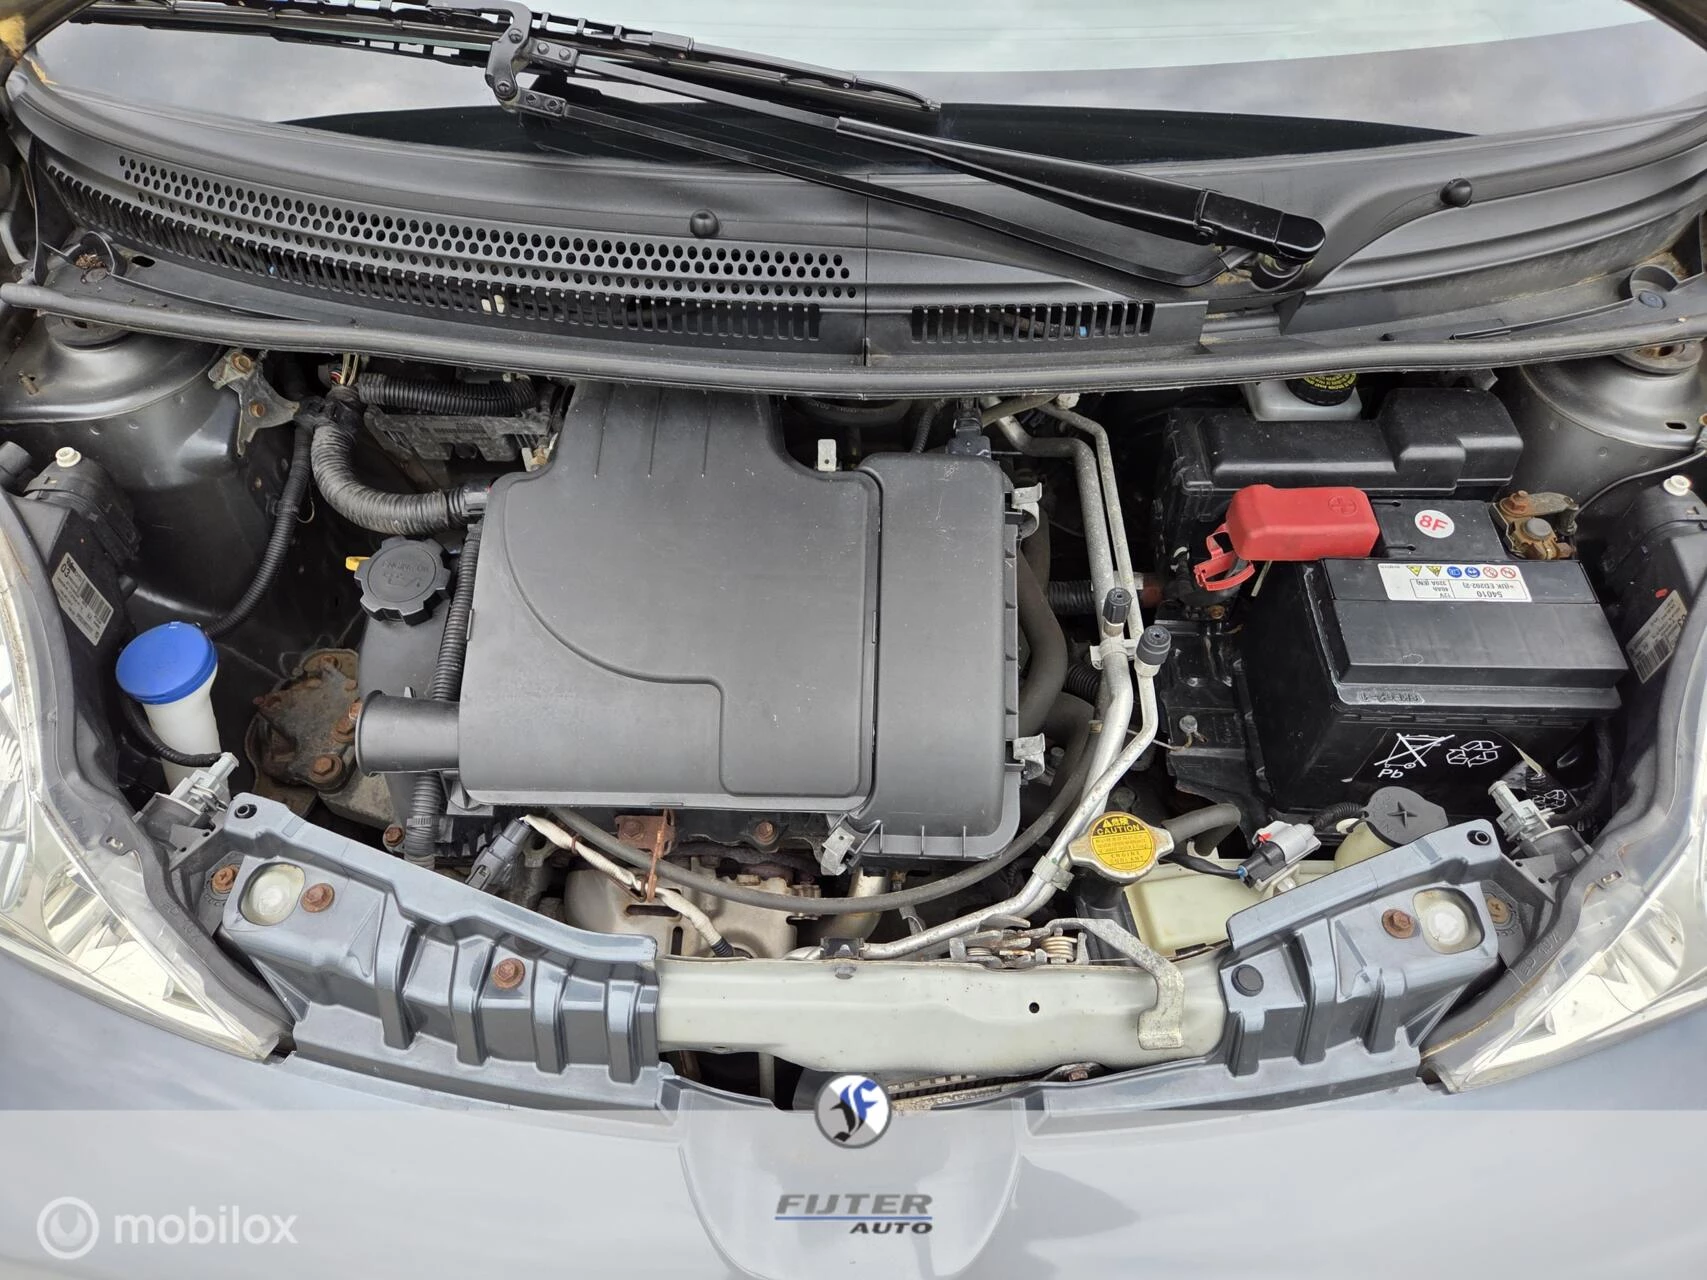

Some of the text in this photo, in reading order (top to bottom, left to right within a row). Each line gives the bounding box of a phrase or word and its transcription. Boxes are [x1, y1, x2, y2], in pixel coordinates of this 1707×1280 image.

[1419, 514, 1449, 531] 8F
[1377, 769, 1404, 778] Pb
[1096, 824, 1140, 835] CAUTION
